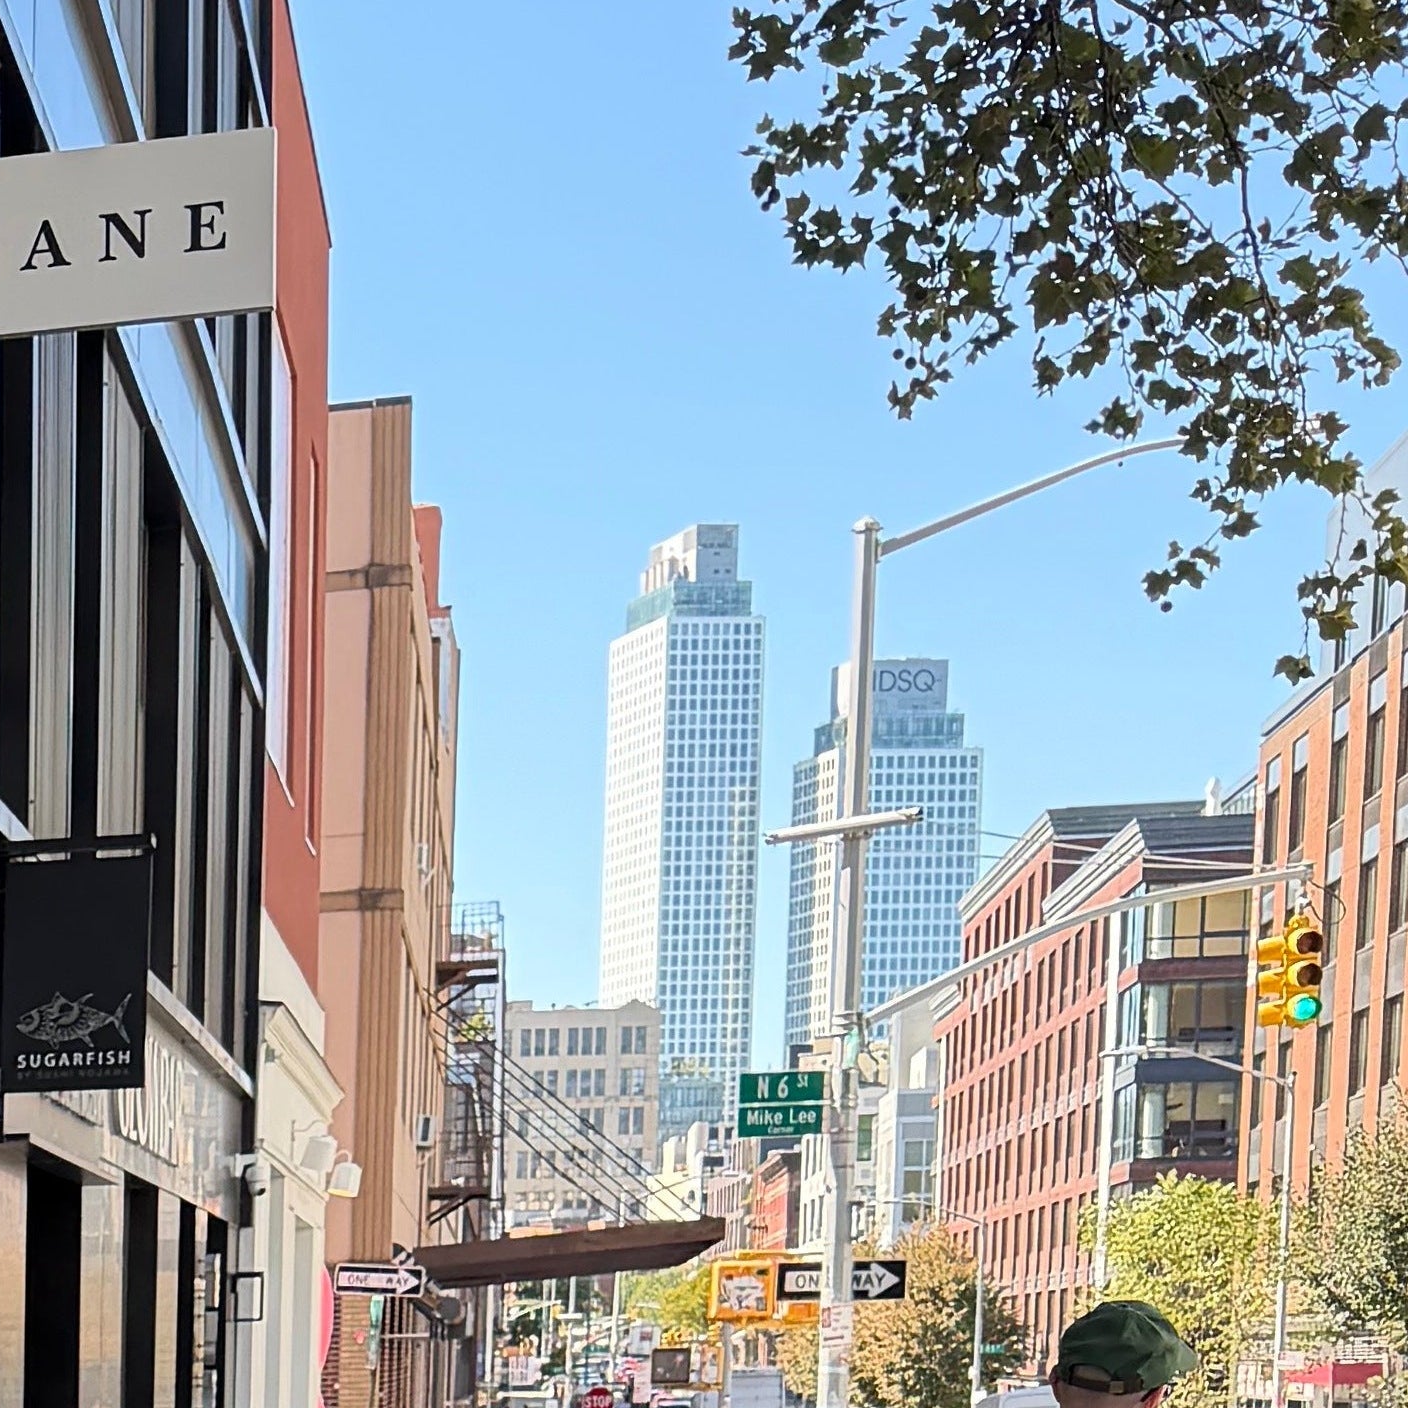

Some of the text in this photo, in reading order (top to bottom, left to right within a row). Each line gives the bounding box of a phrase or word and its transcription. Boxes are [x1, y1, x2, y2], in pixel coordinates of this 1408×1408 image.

[17, 1050, 131, 1069] SUGARFISH
[757, 1075, 770, 1099] N
[777, 1075, 789, 1099] 6
[747, 1107, 817, 1126] Mike Lee
[347, 1273, 410, 1287] ONE WAY
[794, 1273, 819, 1289] ON
[584, 1394, 613, 1408] STOP
